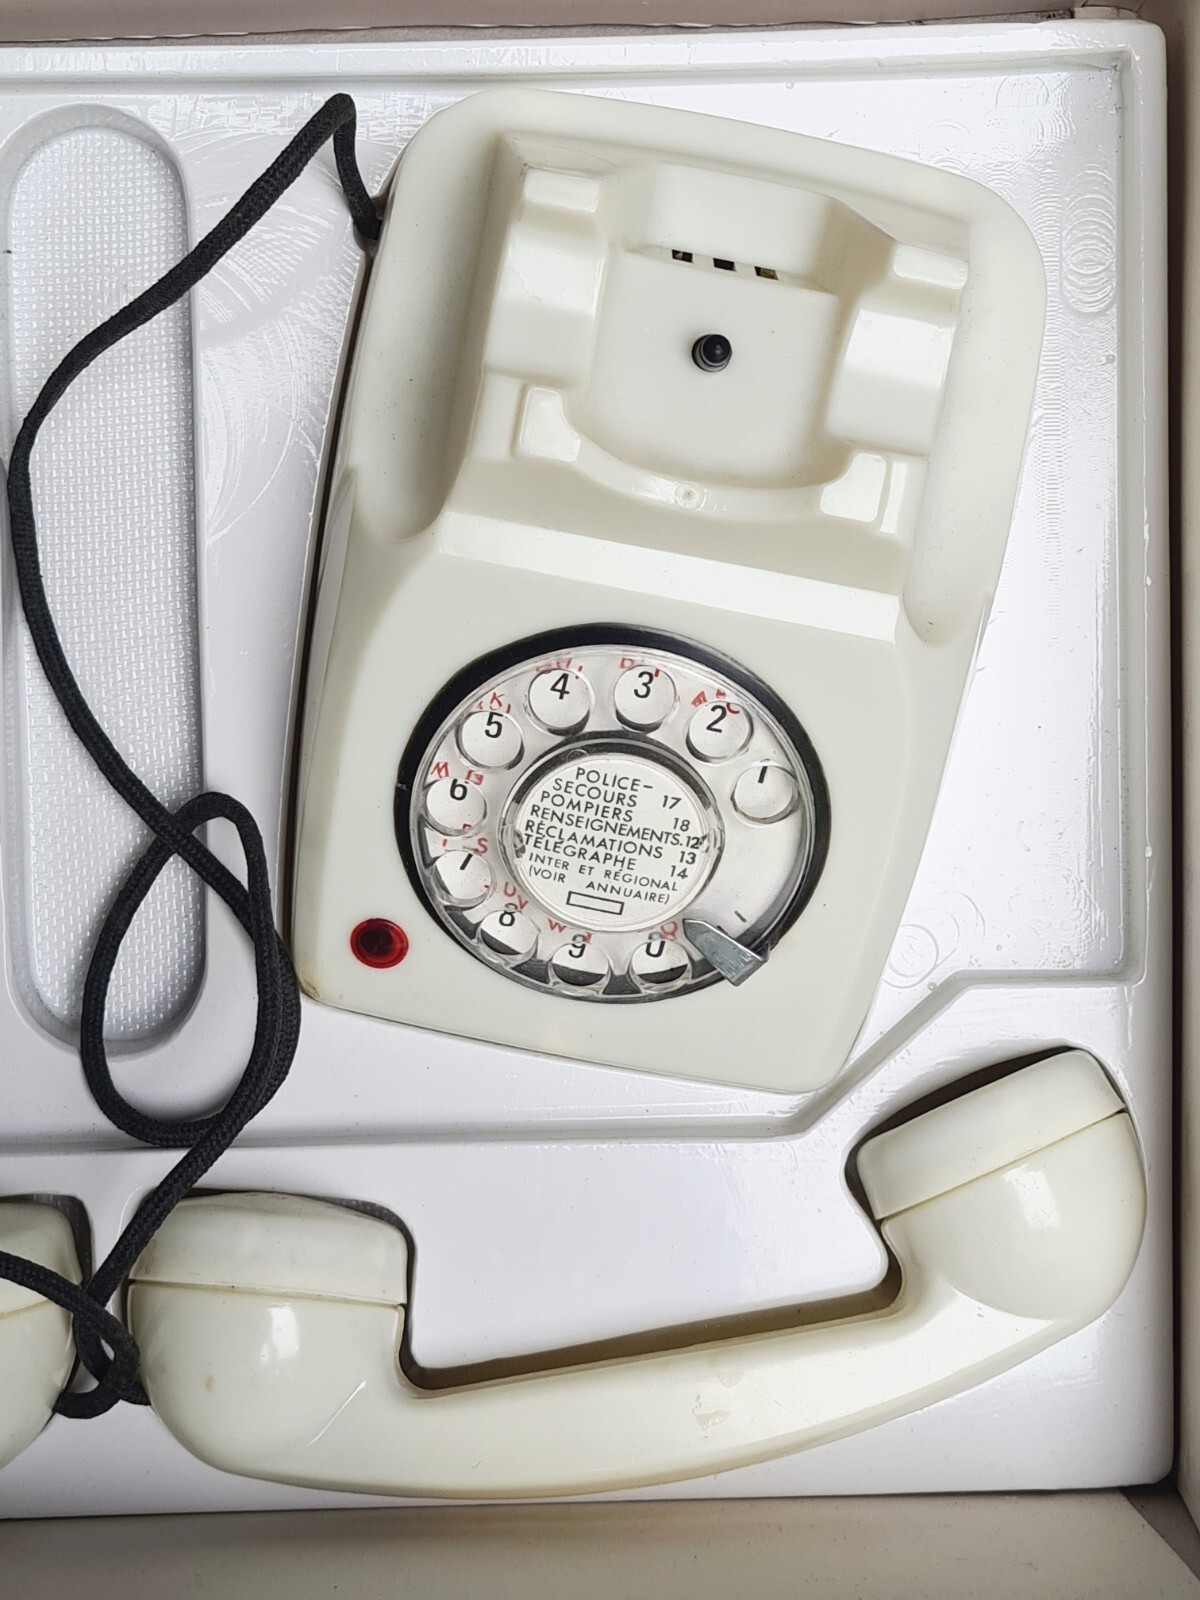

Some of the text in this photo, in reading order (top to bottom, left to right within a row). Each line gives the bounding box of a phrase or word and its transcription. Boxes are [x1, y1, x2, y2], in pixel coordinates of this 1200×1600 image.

[550, 673, 570, 699] 4
[634, 671, 654, 698] 3
[485, 712, 504, 738] 5
[706, 704, 727, 733] 2
[450, 778, 468, 801] 6
[575, 767, 653, 792] POLICE-
[553, 778, 682, 810] SECOURS 17
[540, 790, 690, 832] POMPIERS 18
[525, 819, 697, 865] RÉCLAMATIONS 13
[685, 836, 700, 850] 12
[524, 832, 689, 880] TÉLÉGRAPHE 14
[529, 852, 678, 891] INTER ET RÉGIONAL
[529, 865, 670, 905] (VOIR ANNUAIRE)
[499, 902, 519, 927] 8
[568, 933, 588, 959] 9
[645, 931, 666, 958] 0
